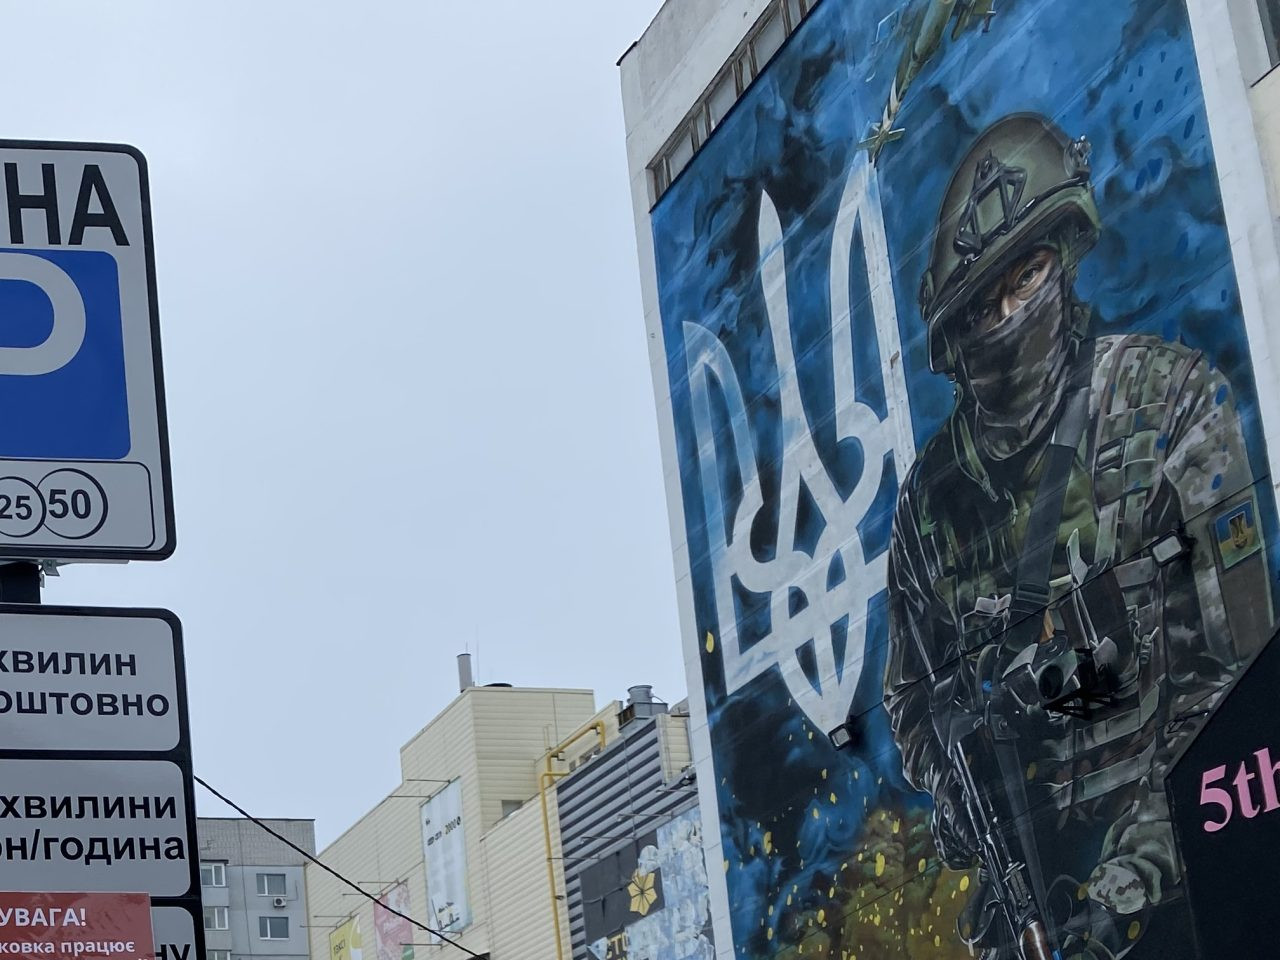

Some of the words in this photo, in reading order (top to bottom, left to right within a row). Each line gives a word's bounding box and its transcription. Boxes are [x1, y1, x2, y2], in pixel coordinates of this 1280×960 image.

[48, 489, 91, 519] 50
[1199, 747, 1280, 833] 5th
[61, 940, 136, 956] працює
